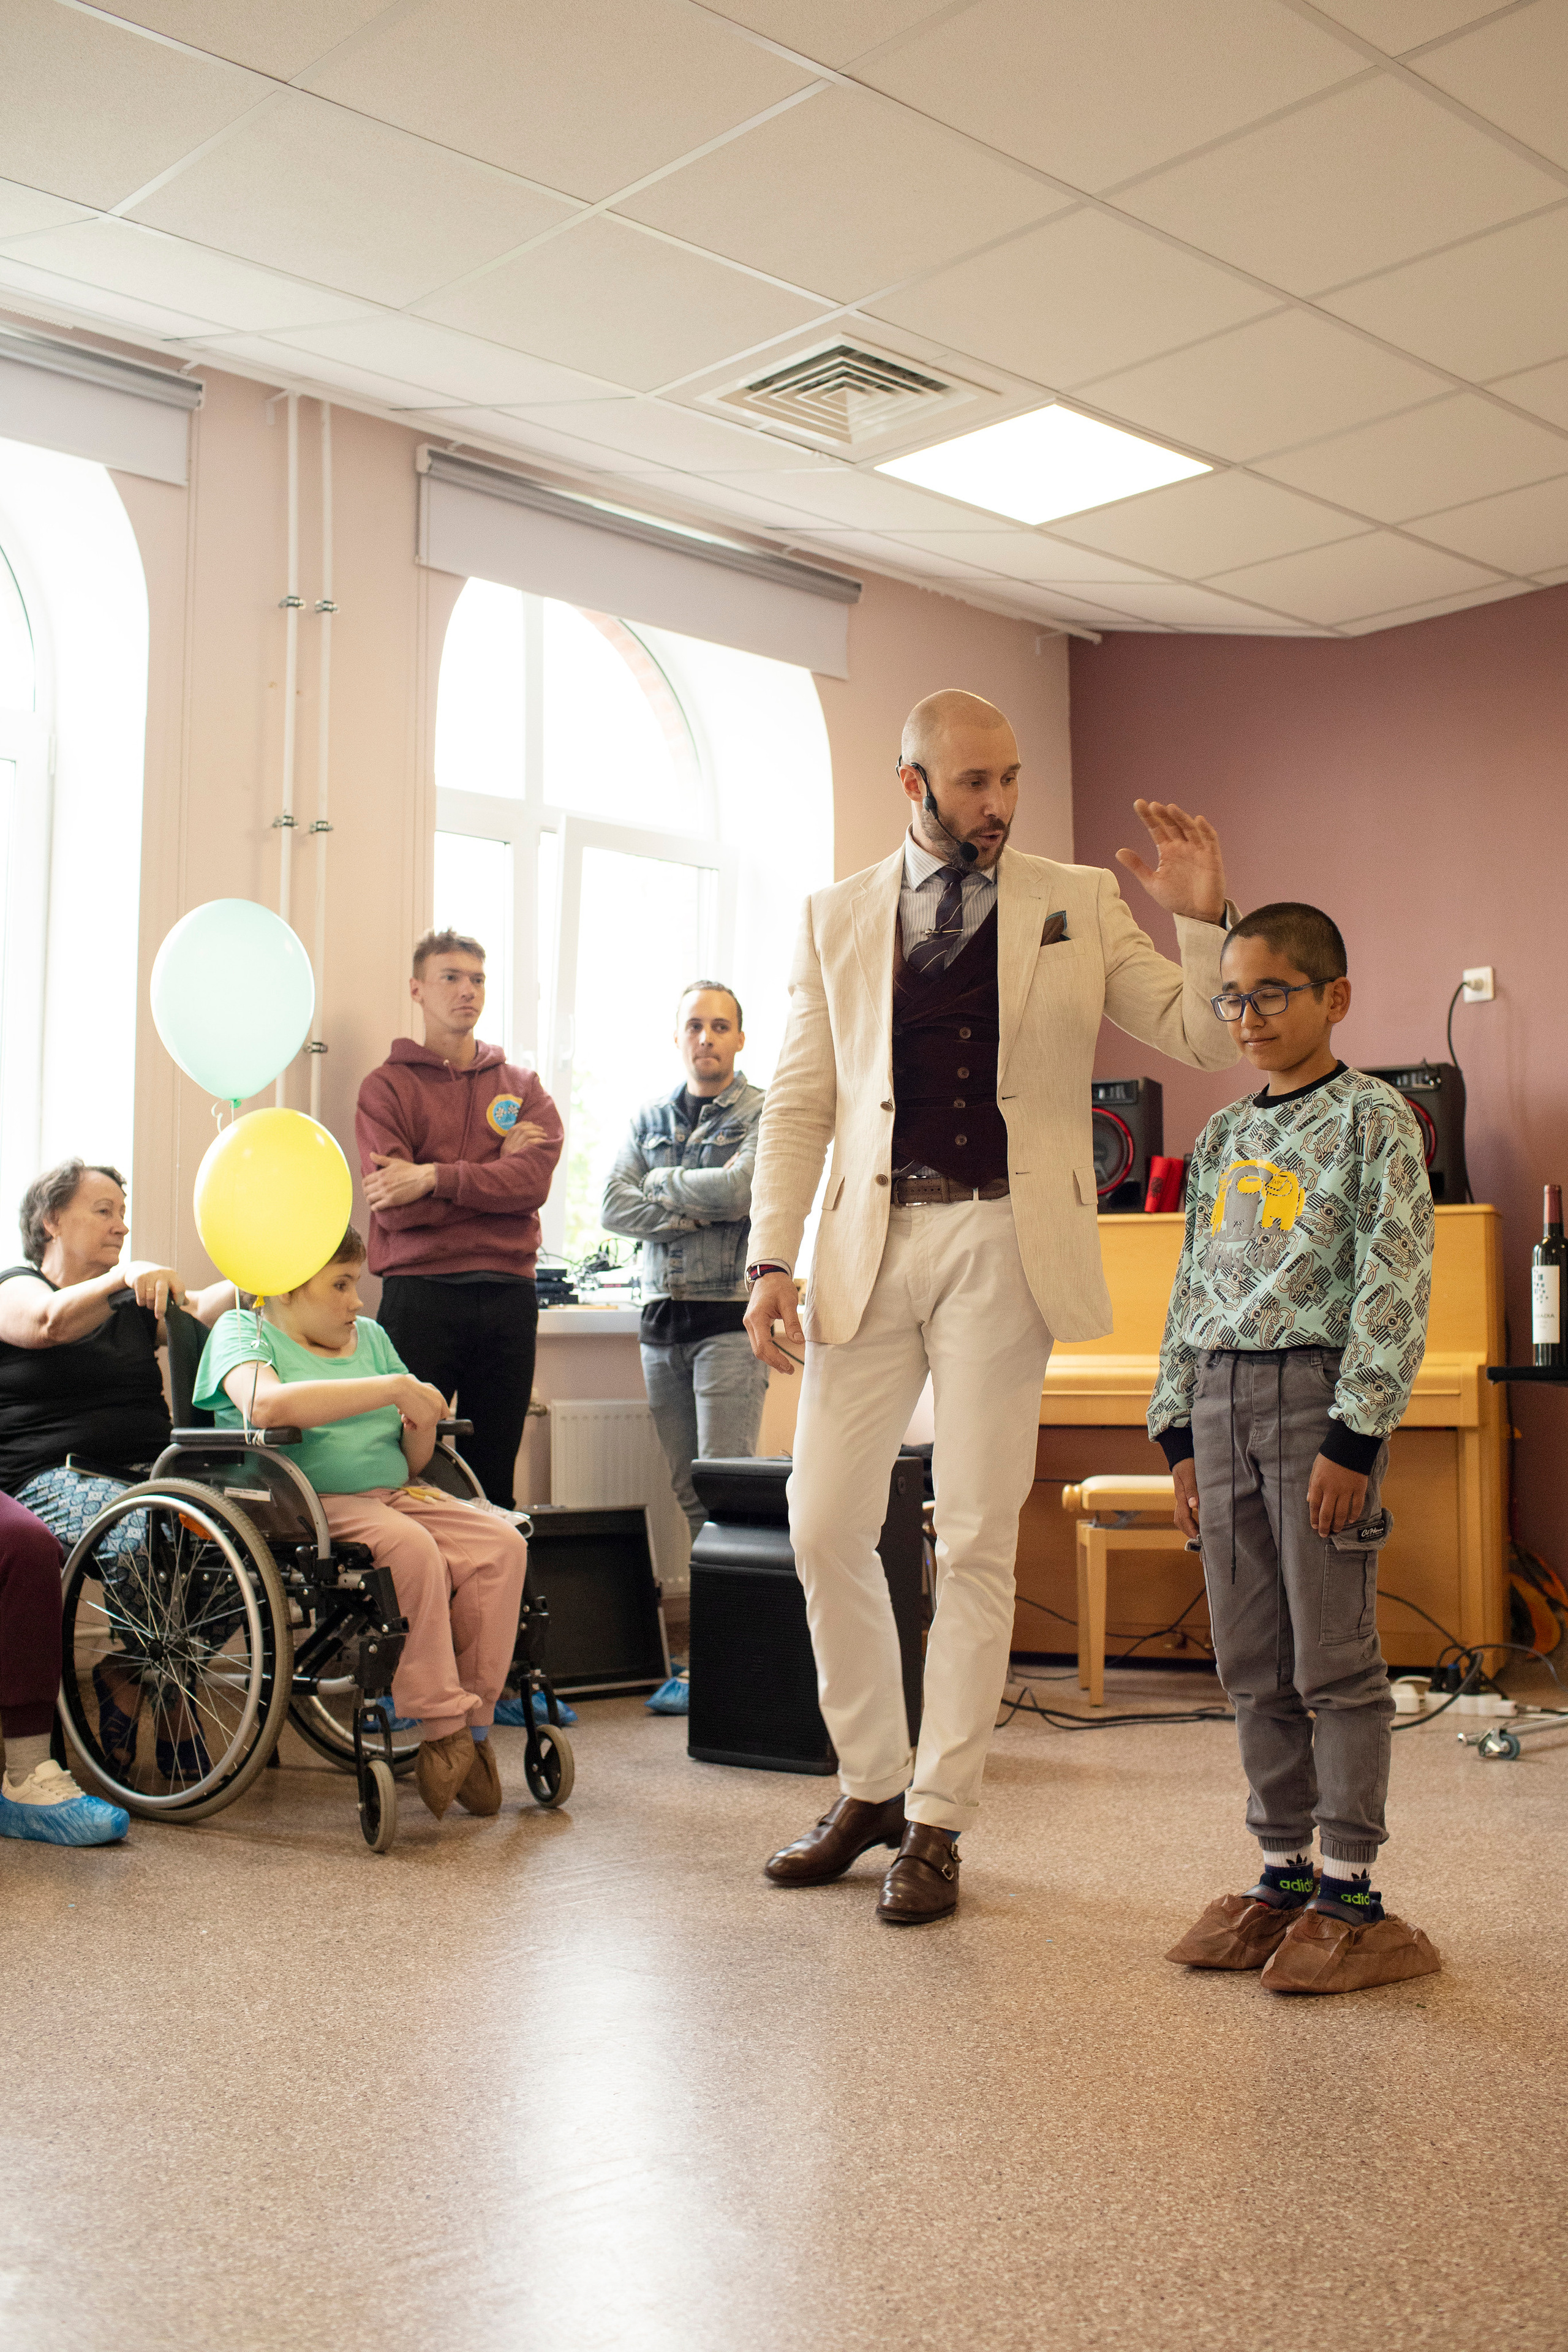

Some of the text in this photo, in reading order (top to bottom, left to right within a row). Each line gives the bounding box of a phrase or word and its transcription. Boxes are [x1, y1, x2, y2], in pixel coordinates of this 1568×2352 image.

[1300, 1115, 1341, 1162] Game
[1250, 1246, 1275, 1269] US
[1286, 1253, 1306, 1273] JUNIOR
[1370, 1246, 1393, 1267] JUNIOR
[1272, 1251, 1314, 1301] Game
[1364, 1285, 1385, 1306] JUNIOR
[1354, 1283, 1394, 1335] Game
